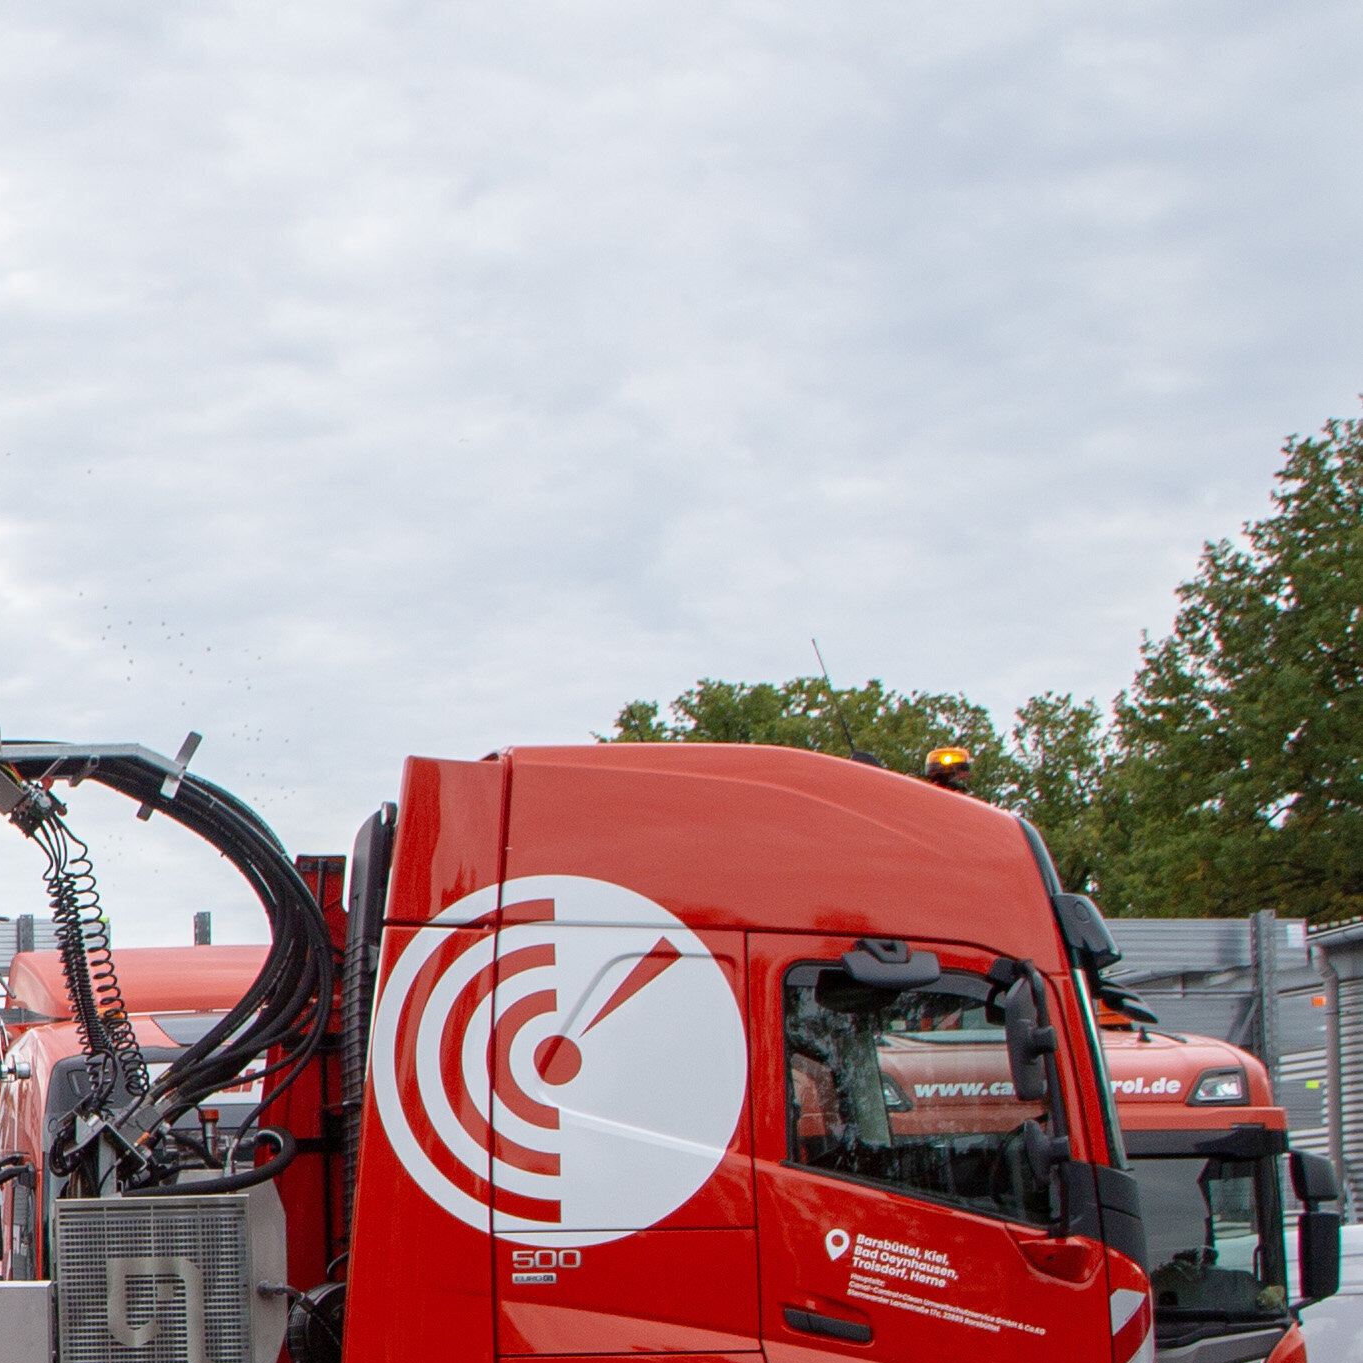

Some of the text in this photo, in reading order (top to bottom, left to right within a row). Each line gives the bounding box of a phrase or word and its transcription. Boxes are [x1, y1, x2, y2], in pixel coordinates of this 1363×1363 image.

[512, 1250, 581, 1269] 500
[854, 1245, 959, 1280] Bad Oeynhausen,
[856, 1233, 950, 1266] Barsbüttel, Kiel,
[852, 1256, 946, 1287] Troisdorf, Herne
